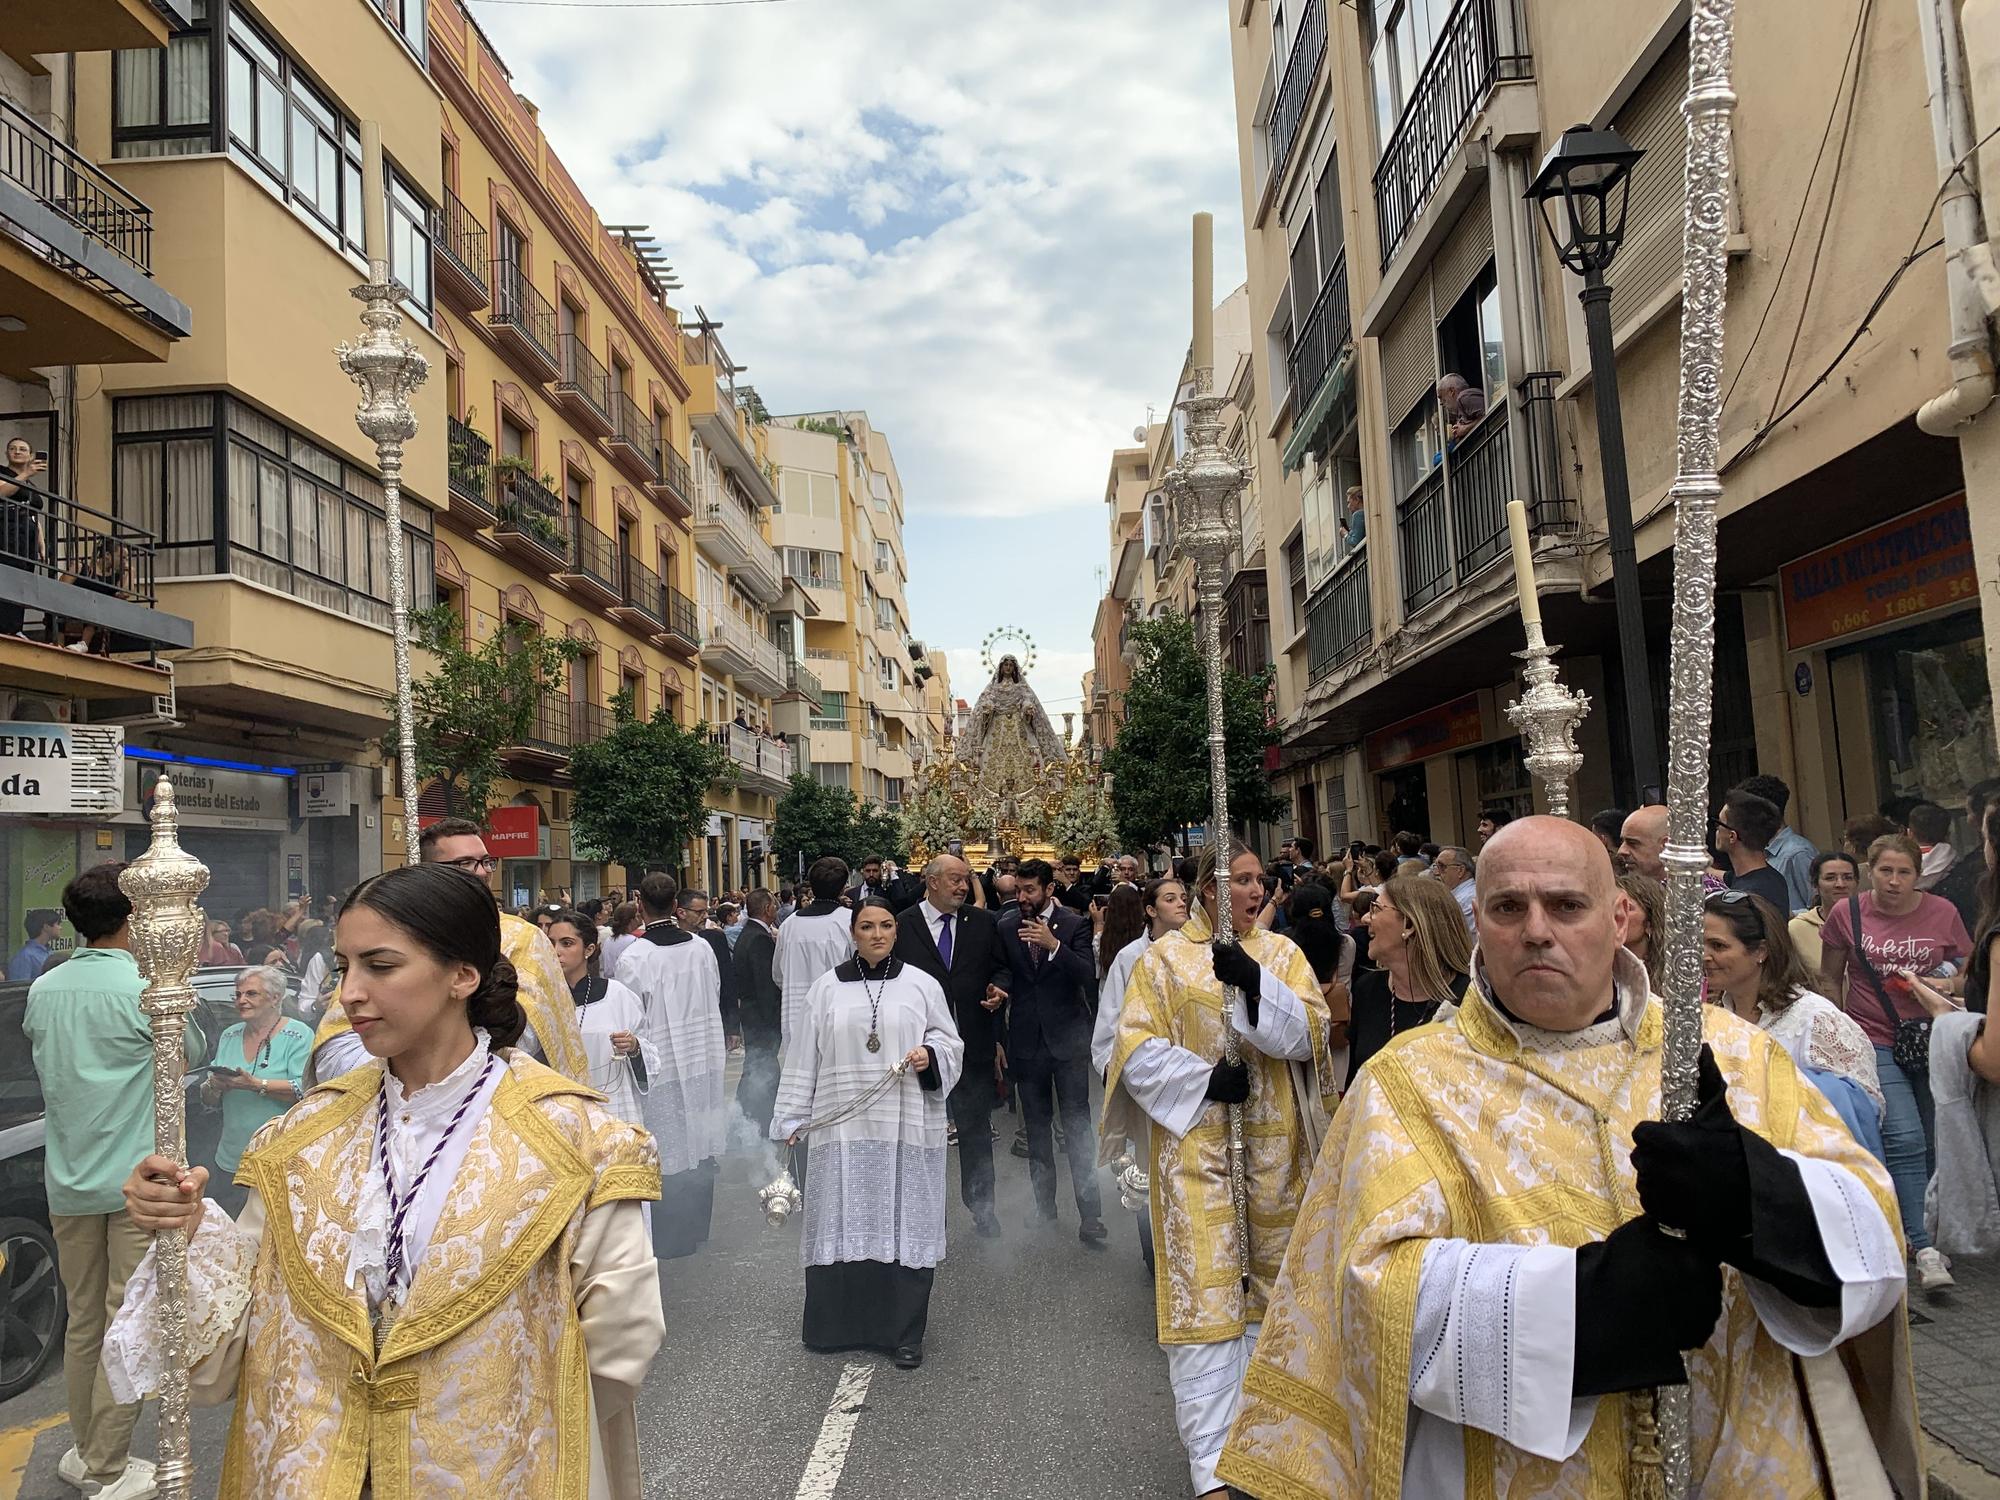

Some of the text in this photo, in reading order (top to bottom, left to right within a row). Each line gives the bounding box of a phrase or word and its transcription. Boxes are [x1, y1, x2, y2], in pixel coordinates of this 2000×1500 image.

[1844, 507, 1971, 583] MULTIPRECIO
[1, 773, 40, 796] da
[209, 778, 214, 793] y
[175, 793, 261, 812] puestas del Estado
[492, 832, 529, 841] MAPFRE
[48, 937, 73, 951] LERIA
[1861, 933, 1935, 961] Perfectly
